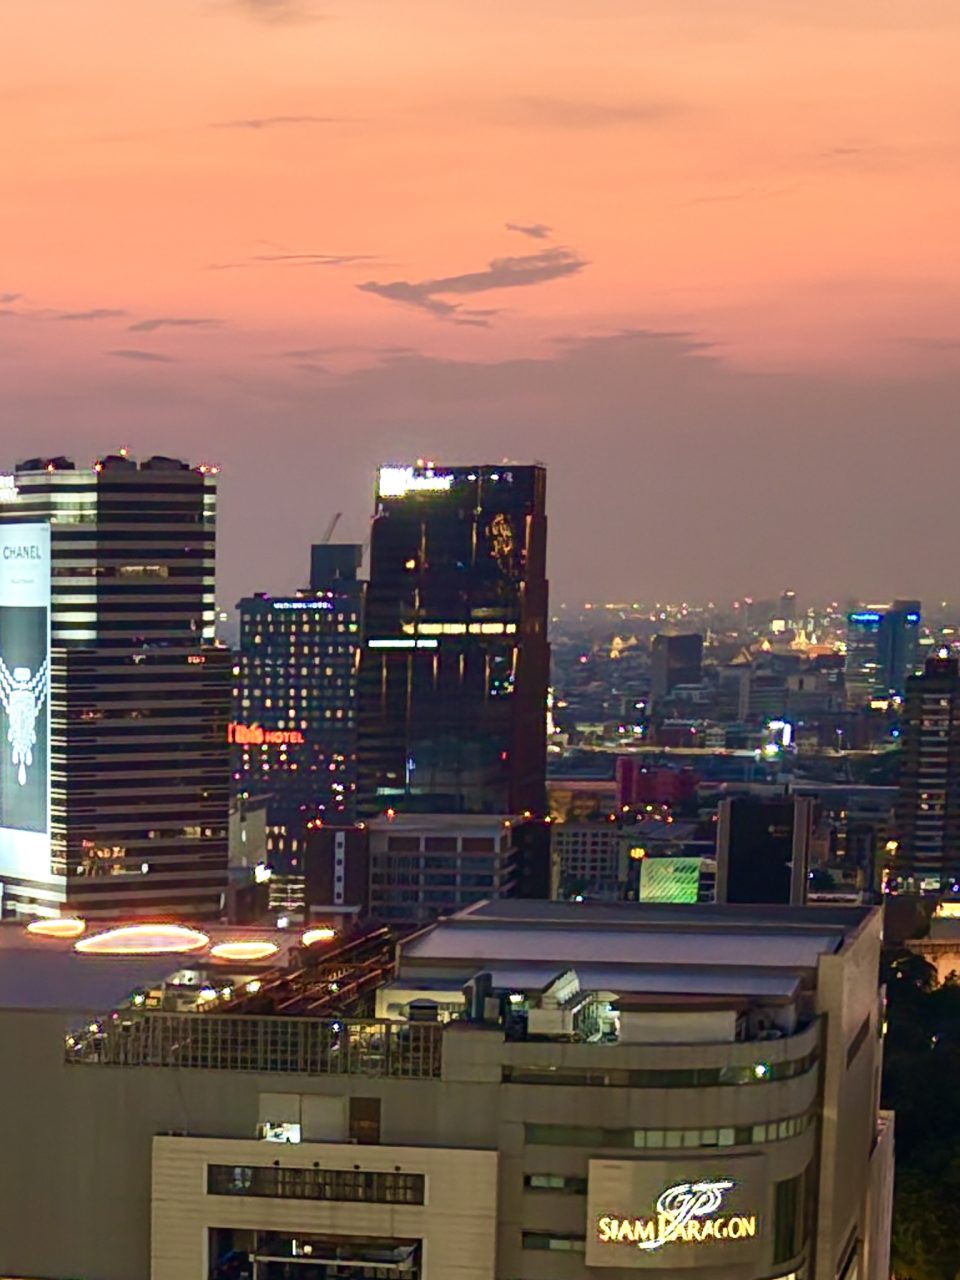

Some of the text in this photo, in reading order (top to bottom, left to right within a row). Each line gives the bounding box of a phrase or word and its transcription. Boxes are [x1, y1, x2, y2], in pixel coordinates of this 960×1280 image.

[3, 545, 42, 560] CHANEL
[265, 731, 305, 743] HOTEL
[598, 1213, 756, 1242] SIAM PARAGON
